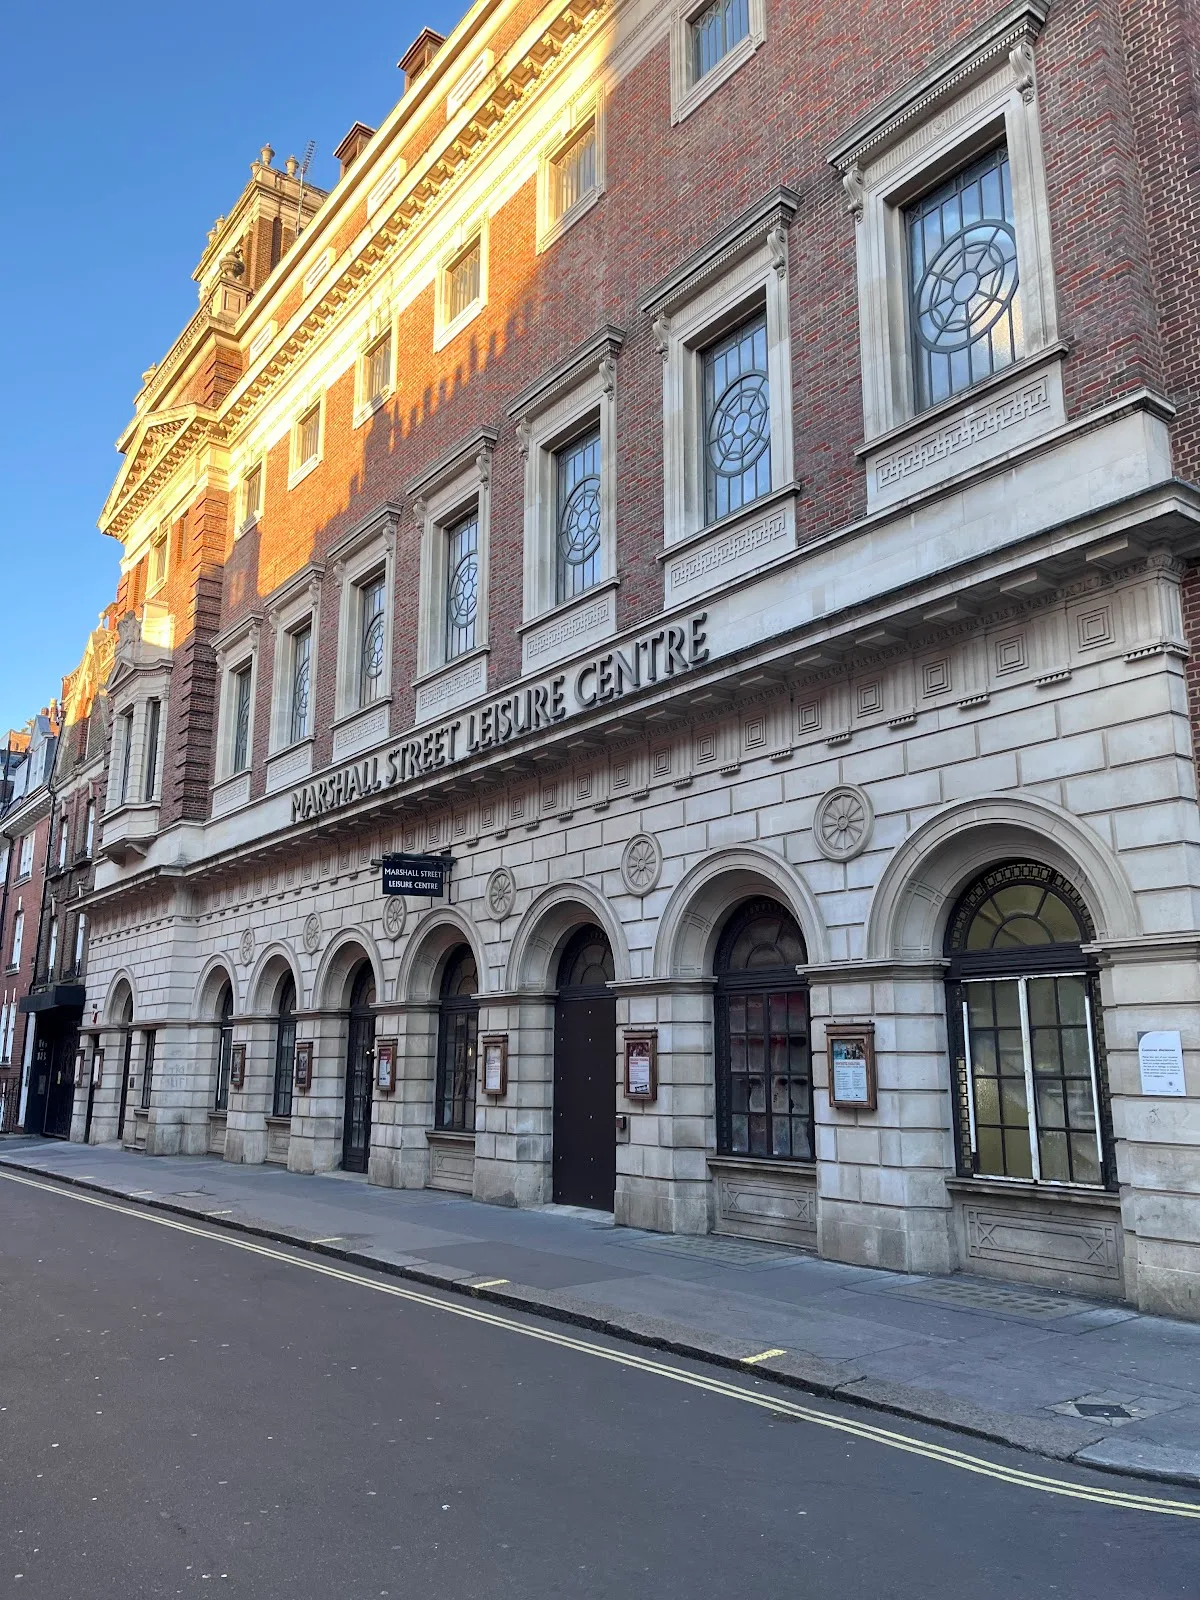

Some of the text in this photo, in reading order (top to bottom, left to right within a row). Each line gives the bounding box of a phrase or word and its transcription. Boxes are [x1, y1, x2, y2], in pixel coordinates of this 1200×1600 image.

[290, 612, 710, 822] MARSHALL STREET LEISURE CENTRE
[384, 868, 442, 878] MARSHALL STREET
[388, 880, 438, 890] LEISURE CENTRE
